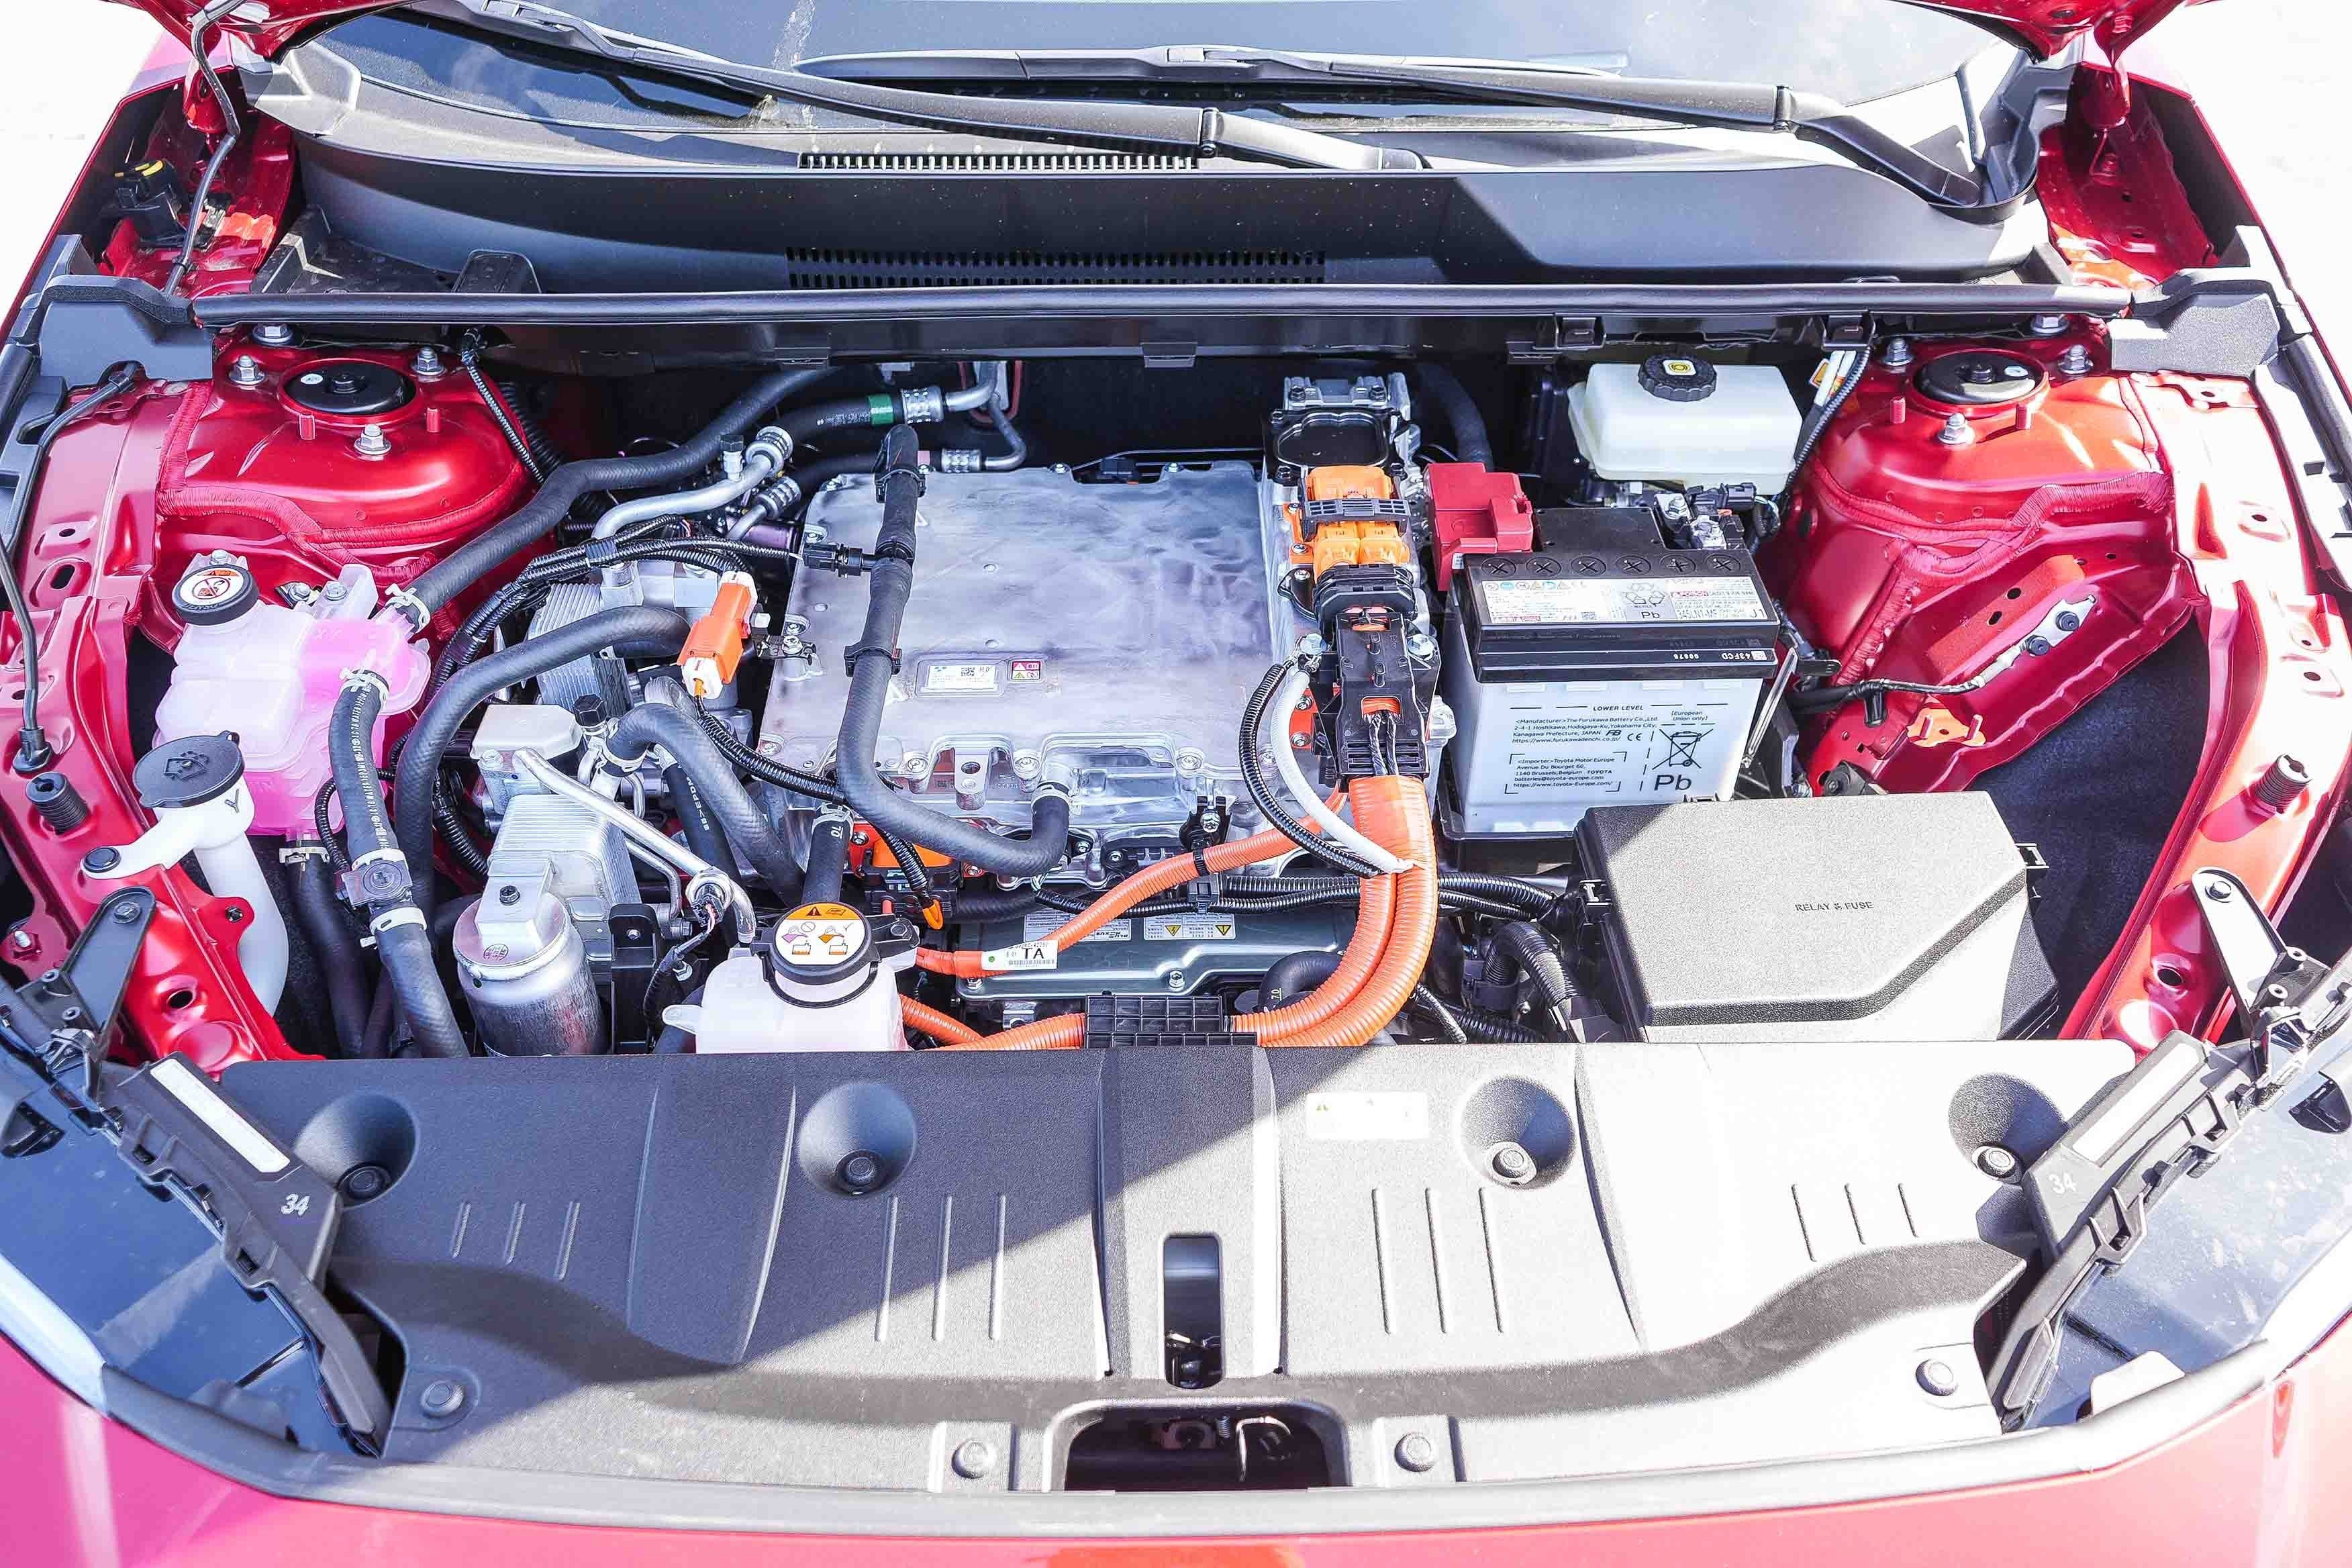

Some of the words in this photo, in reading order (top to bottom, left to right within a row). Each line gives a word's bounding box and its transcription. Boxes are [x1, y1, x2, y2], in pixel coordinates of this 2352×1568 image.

[1653, 774, 1692, 791] Pb
[1795, 903, 1830, 912] RELAY
[1845, 901, 1874, 910] FUSE
[1021, 948, 1044, 959] TA
[2049, 1173, 2077, 1194] 34
[281, 1193, 311, 1216] 34
